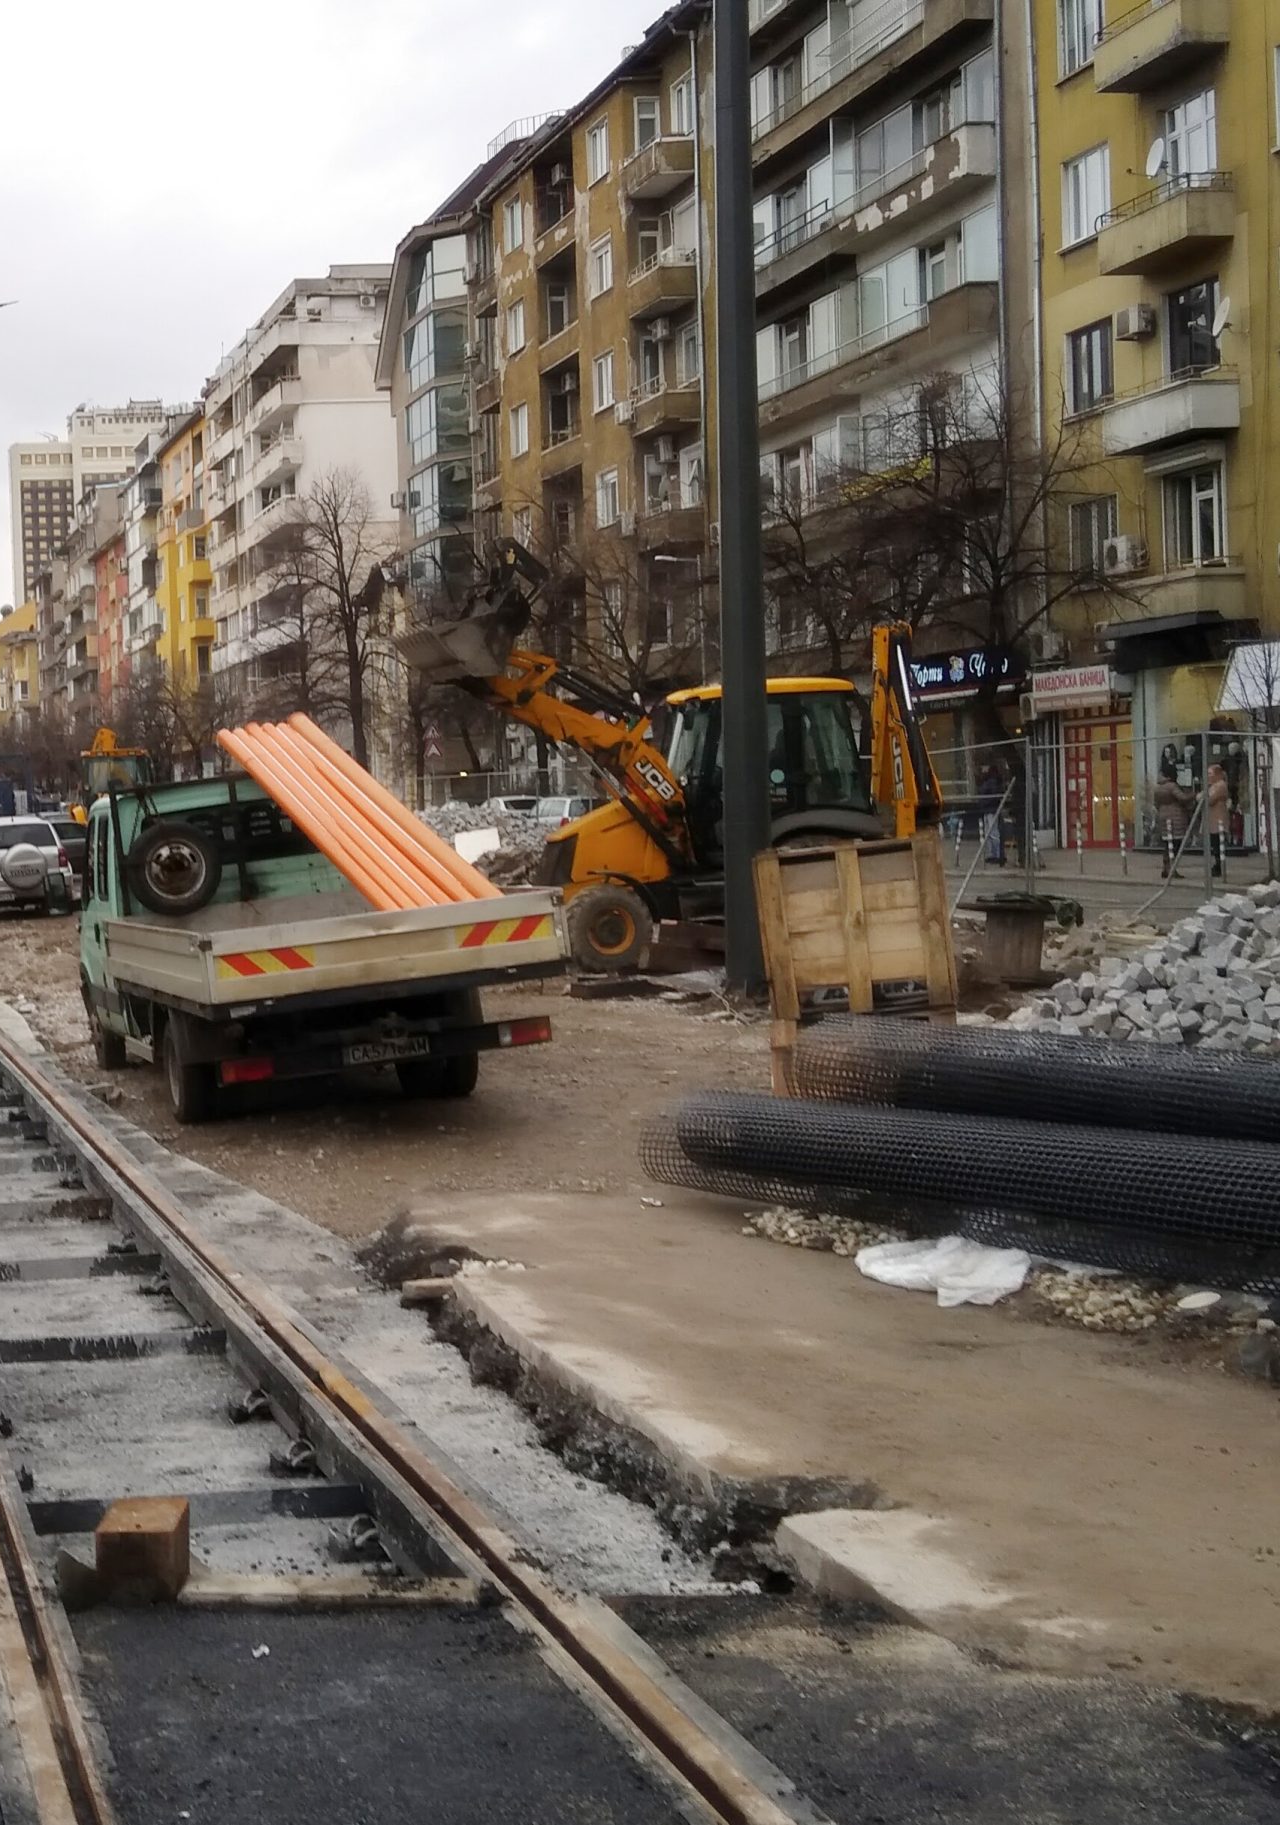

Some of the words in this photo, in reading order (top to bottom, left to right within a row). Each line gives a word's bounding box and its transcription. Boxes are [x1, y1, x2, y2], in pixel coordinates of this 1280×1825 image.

[1035, 673, 1078, 693] МАКЕДОНСКА
[1079, 669, 1107, 688] БАНИЦА
[634, 760, 676, 801] JCB
[892, 736, 905, 801] JCB
